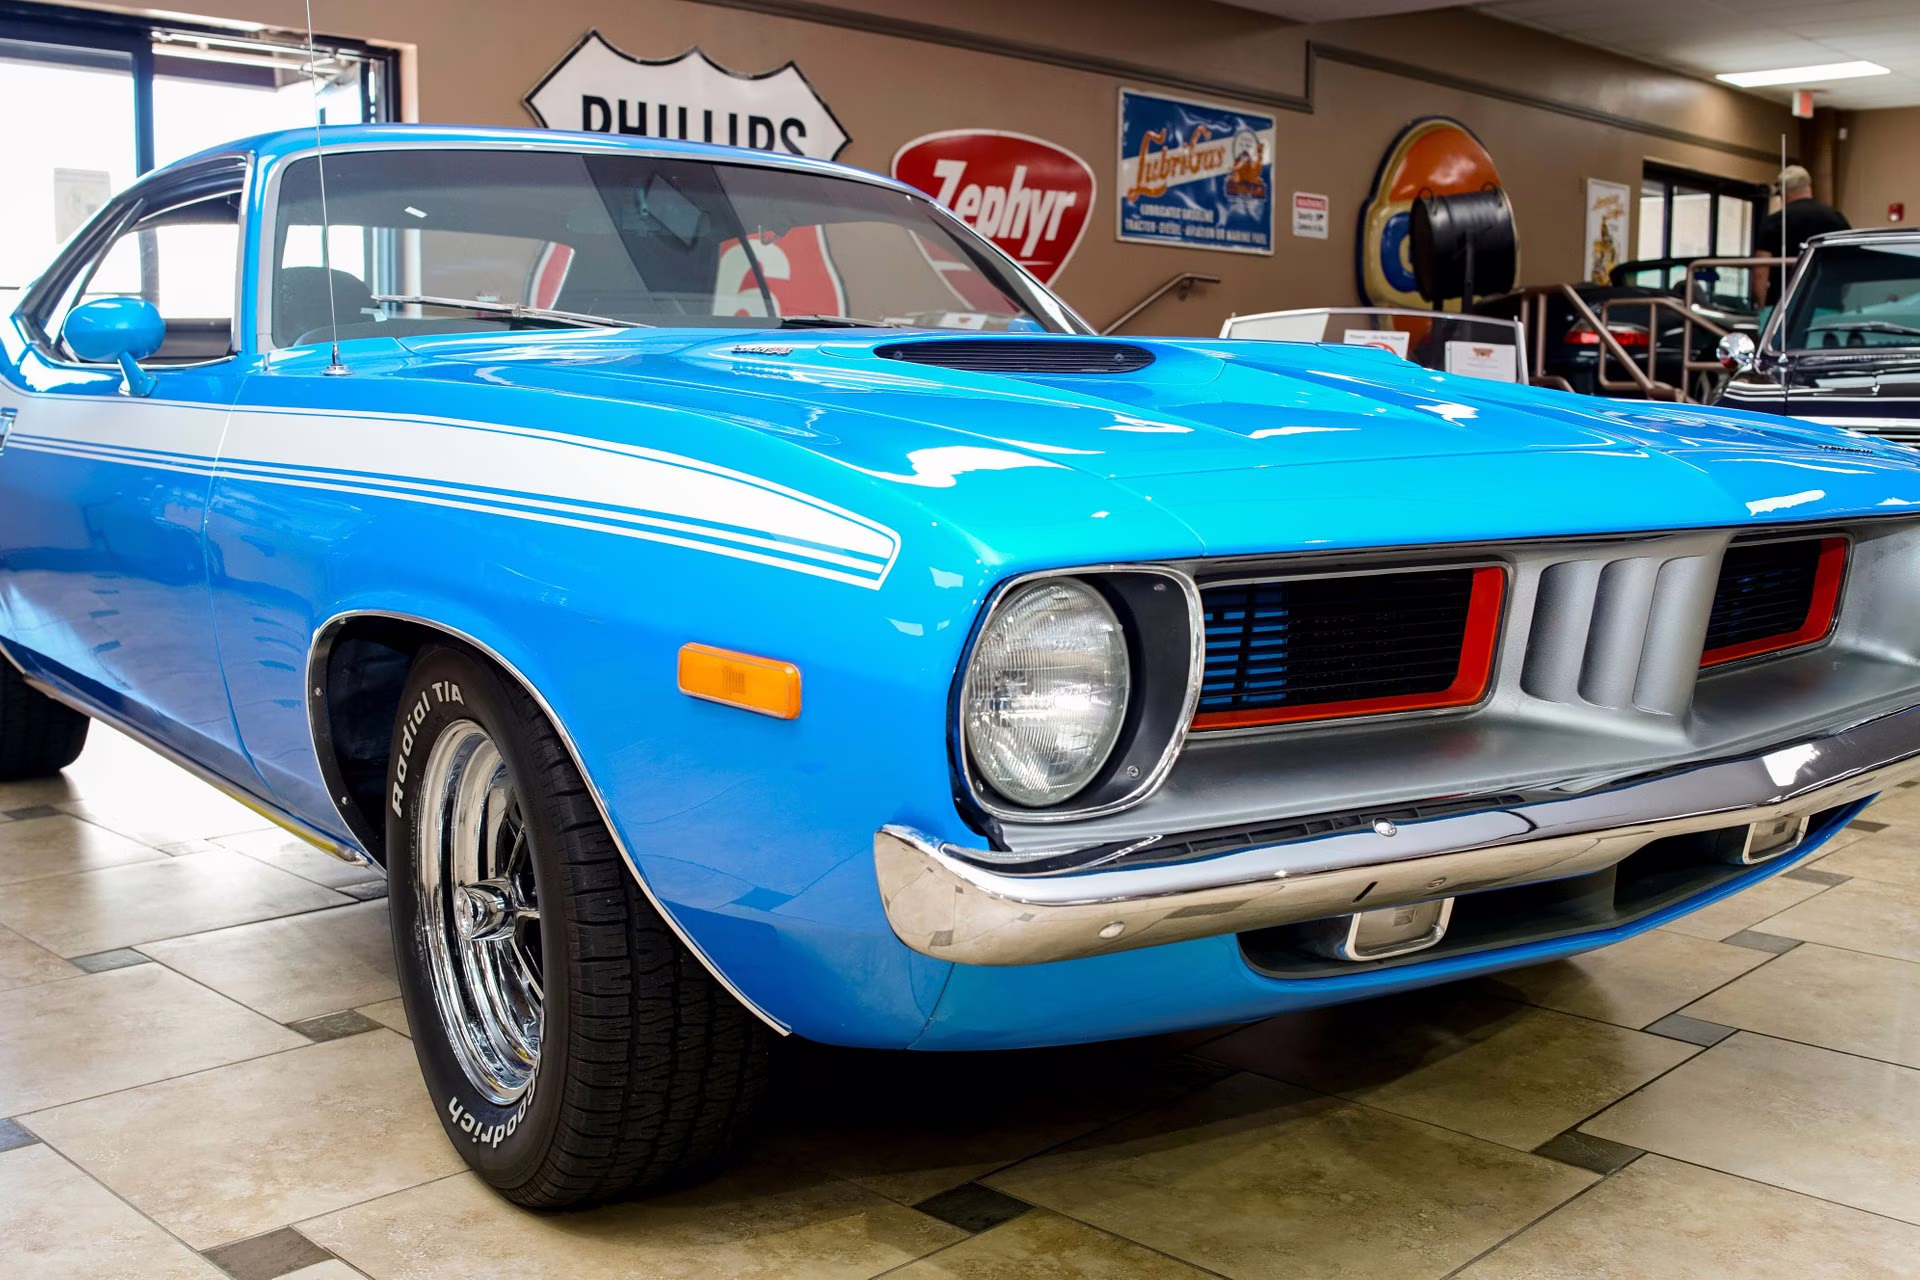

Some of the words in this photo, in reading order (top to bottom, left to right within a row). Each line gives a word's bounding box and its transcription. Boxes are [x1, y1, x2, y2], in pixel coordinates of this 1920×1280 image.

[933, 159, 1078, 258] Zephyr
[392, 691, 431, 819] Radial
[431, 680, 465, 706] T/A
